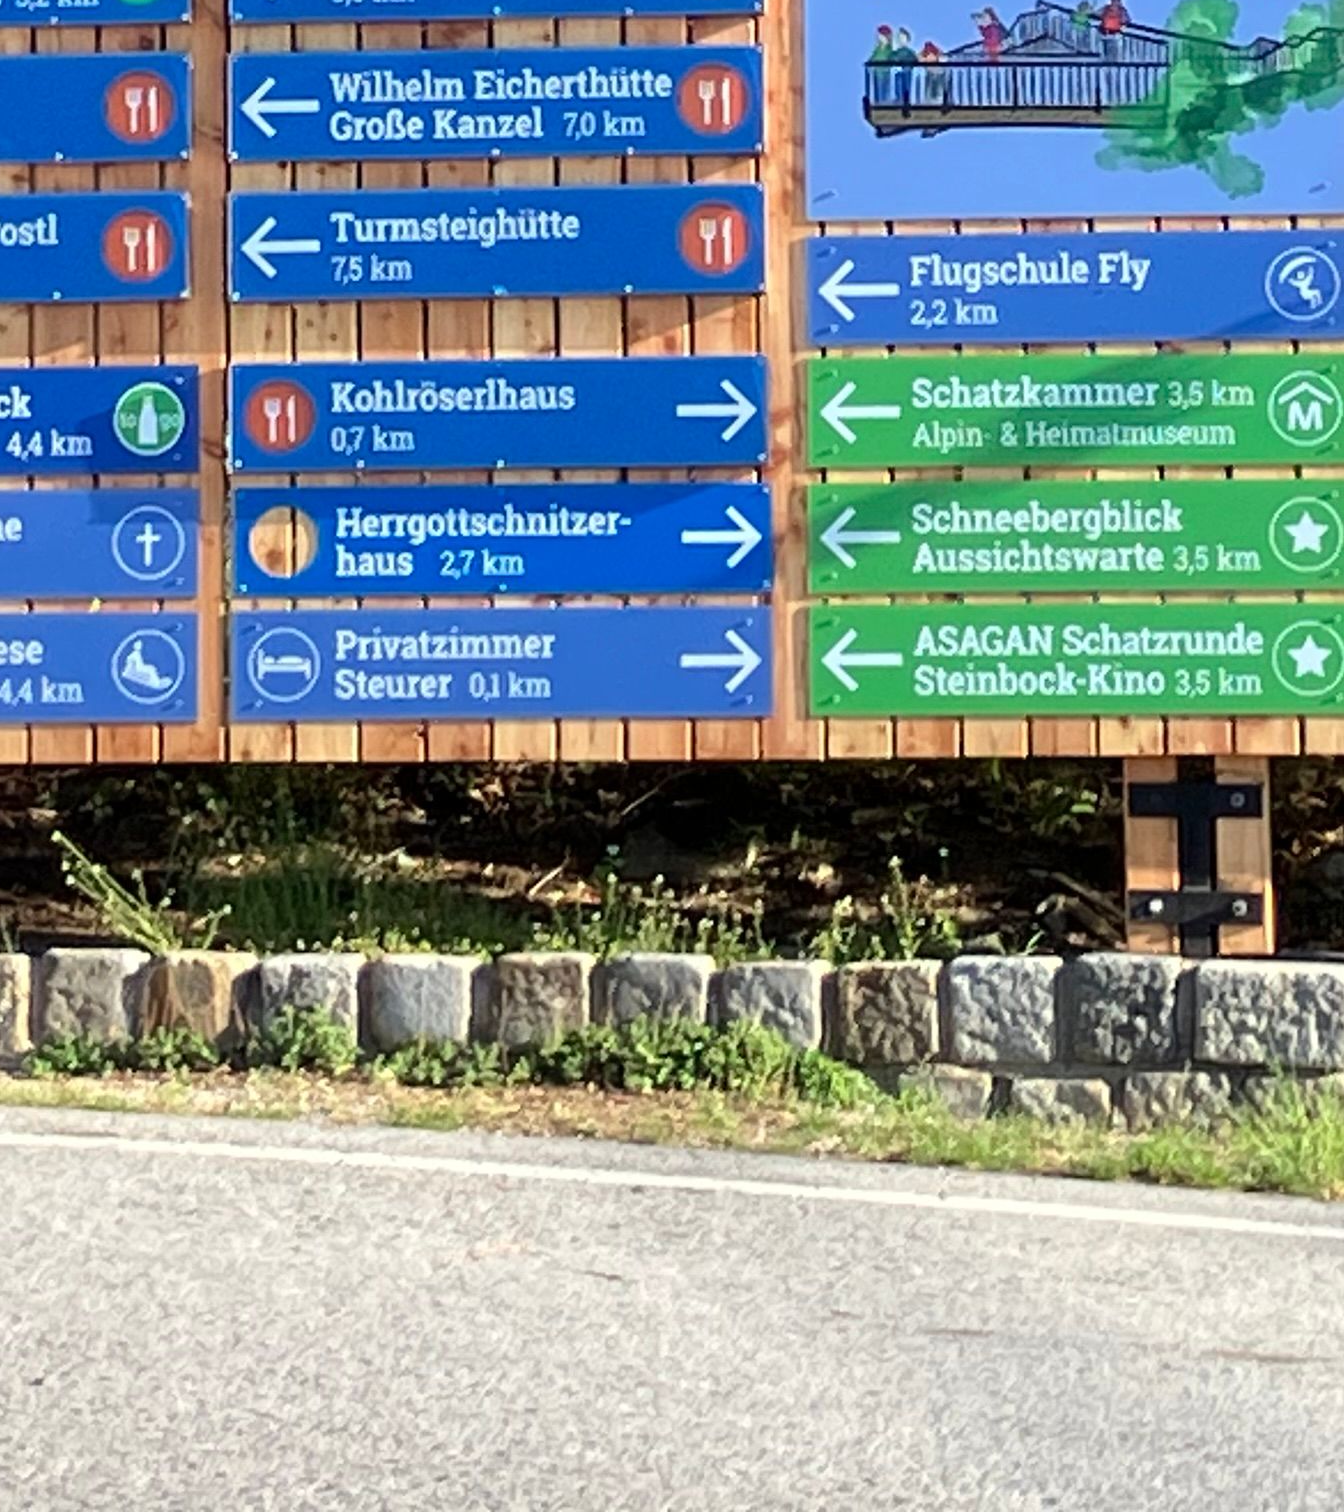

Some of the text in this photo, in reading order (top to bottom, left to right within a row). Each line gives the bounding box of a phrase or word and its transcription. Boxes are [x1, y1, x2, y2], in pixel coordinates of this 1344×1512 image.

[329, 65, 673, 105] Wilhelm Eicherthütte
[330, 106, 646, 141] Große Kanzel 7,0 km
[330, 205, 581, 248] Turmsteighütte
[330, 255, 413, 284] 7,5 km
[909, 253, 1151, 293] Flugschule Fly
[910, 299, 998, 329] 2,2 km
[330, 379, 576, 414] Kohlröserlhaus
[912, 376, 1255, 409] Schatzkammer 3,5 km
[5, 432, 44, 462] 4,4
[50, 431, 93, 456] km
[330, 426, 415, 455] 0,7 km
[1000, 421, 1019, 446] &
[1025, 419, 1236, 448] Heimatmuseum
[335, 505, 632, 546] Herrgottschnitzer-
[912, 499, 1183, 540] Schneebergblick
[335, 545, 525, 578] haus 2,7 km
[912, 541, 1261, 574] Aussichtswarte 3,5 km
[334, 626, 556, 662] Privatzimmer
[914, 623, 1263, 657] ASAGAN Schatzrunde
[41, 677, 84, 703] km
[334, 668, 551, 702] Steurer 0,1 km
[914, 661, 1262, 698] Steinbock-Kino 3,5 km
